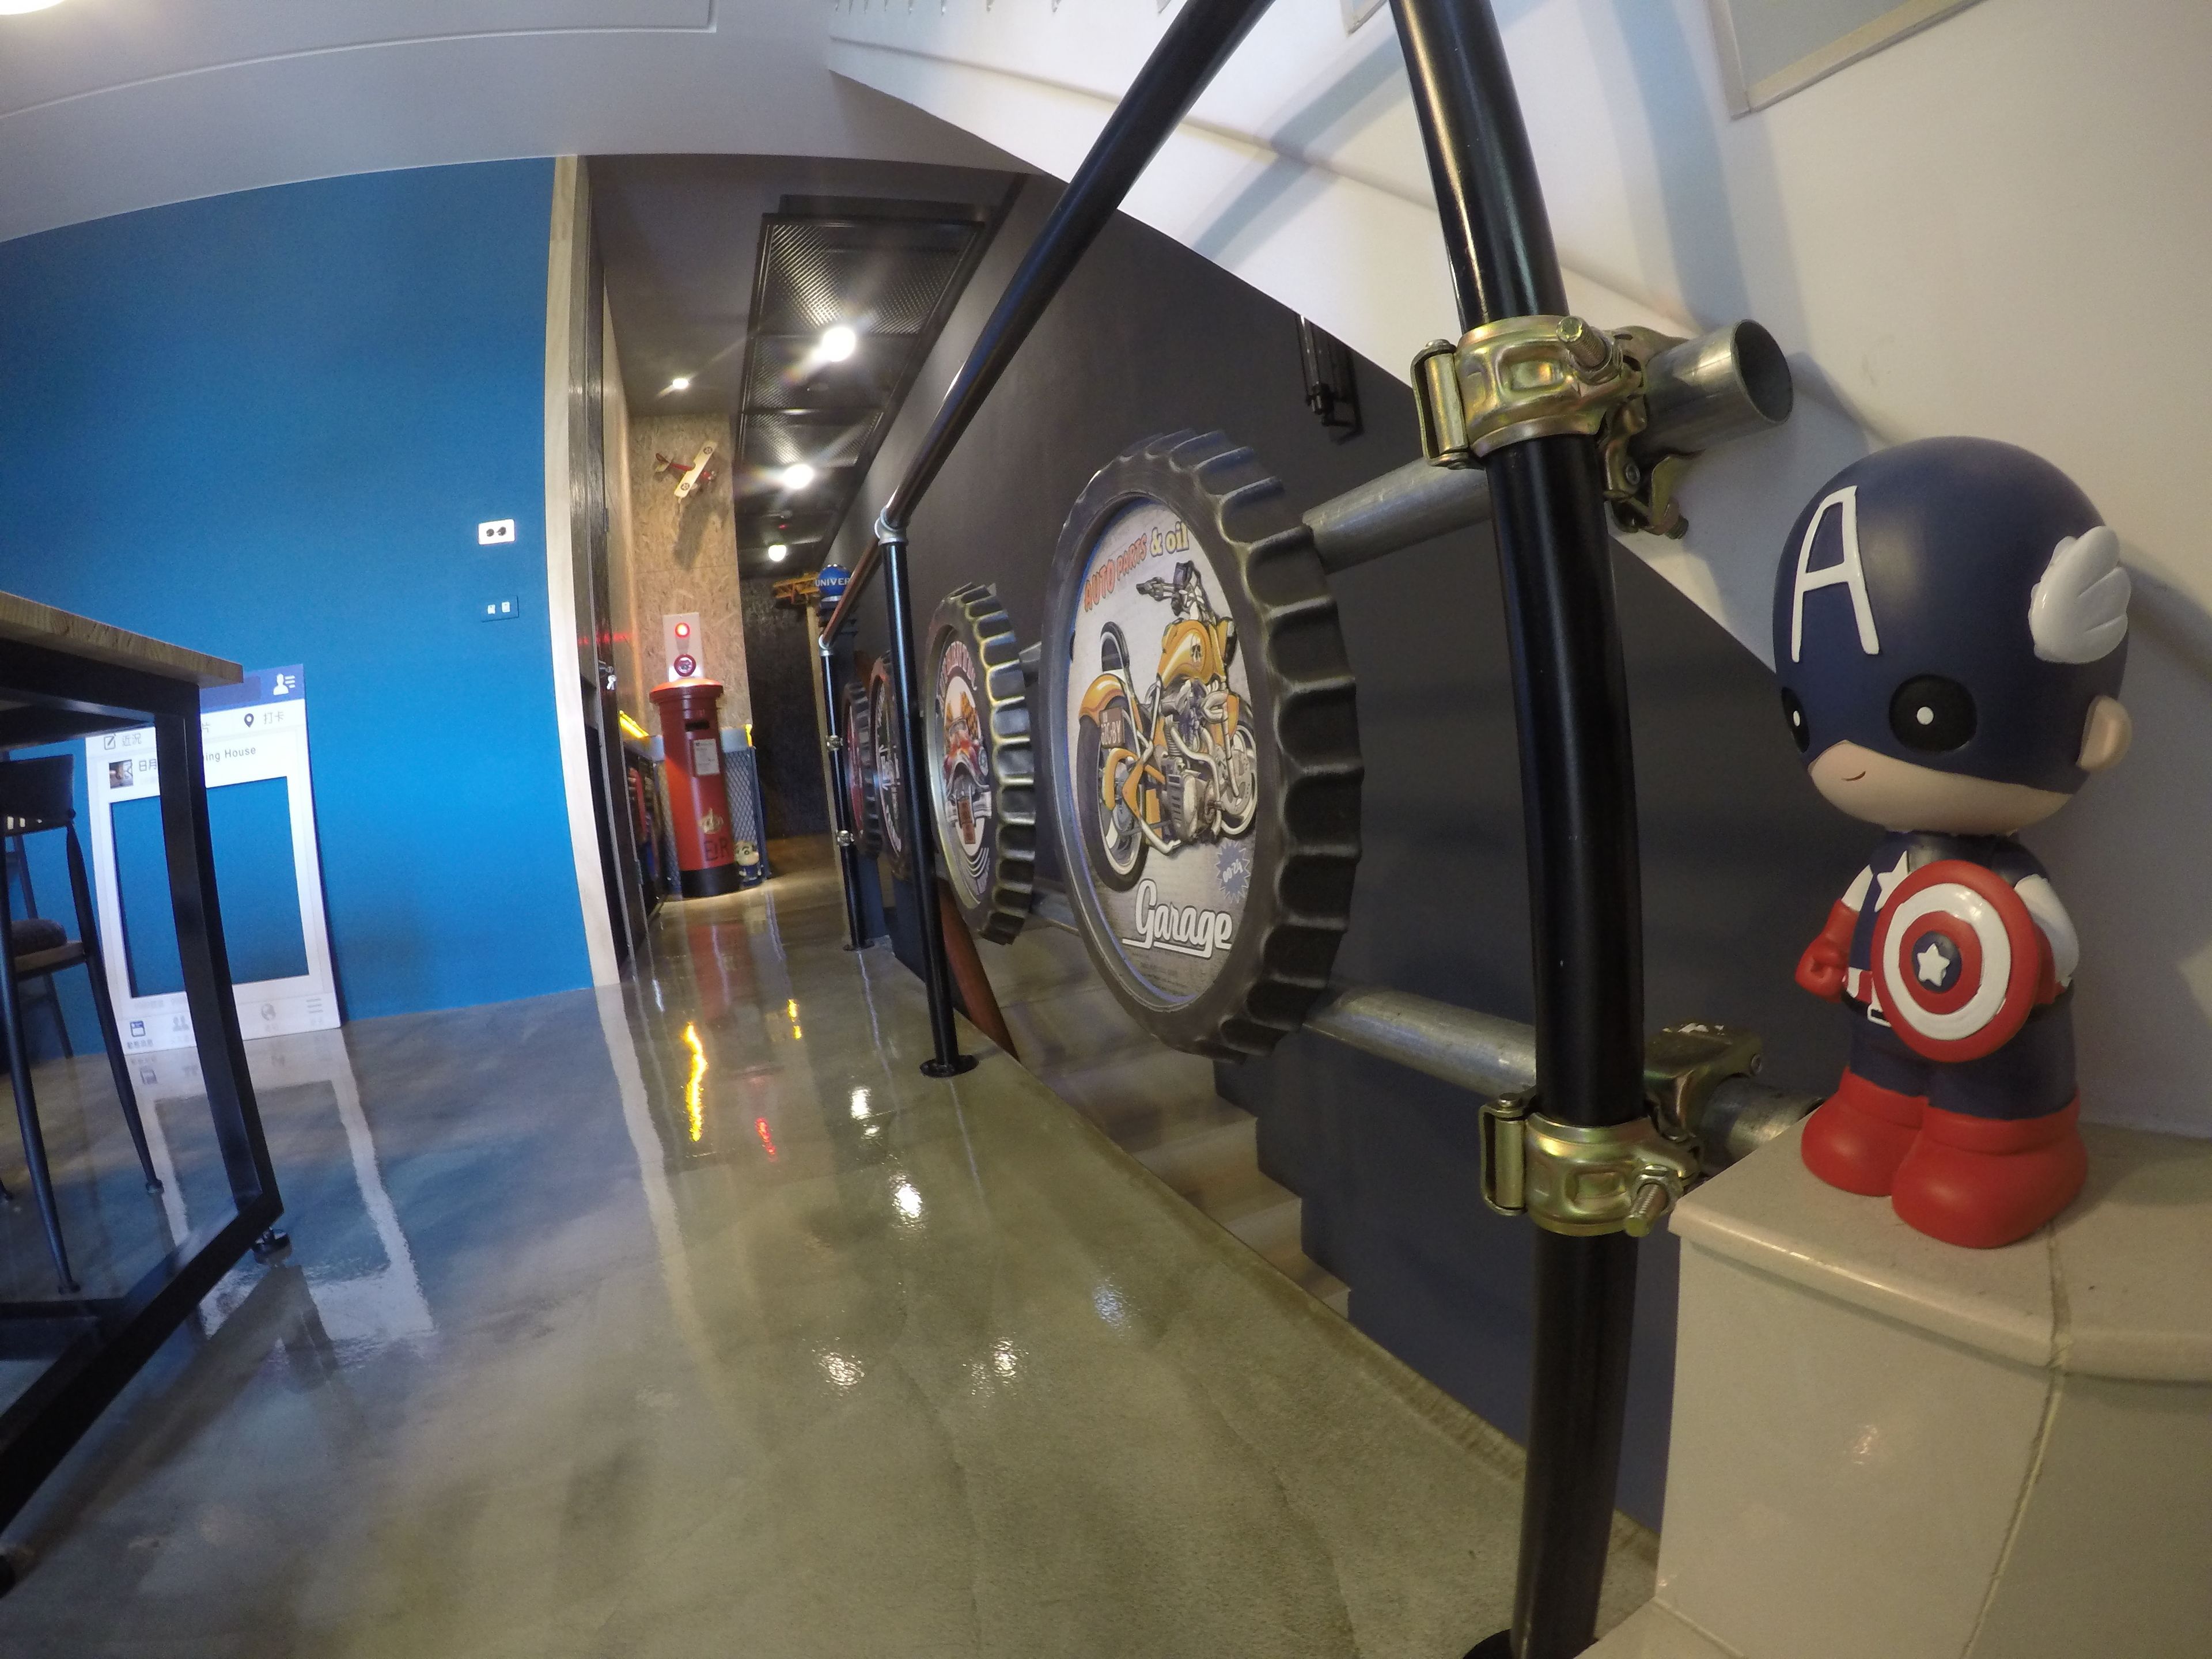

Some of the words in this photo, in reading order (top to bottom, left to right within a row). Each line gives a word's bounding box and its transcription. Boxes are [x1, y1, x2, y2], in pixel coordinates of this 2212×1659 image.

[1084, 559, 1115, 612] AUTO
[1116, 533, 1147, 581] PARTS
[1150, 527, 1164, 558] &
[1165, 521, 1190, 554] oil
[1791, 485, 1880, 663] A
[205, 752, 221, 762] ing
[224, 747, 256, 758] House
[263, 711, 284, 725] 打卡
[1122, 878, 1233, 960] Garage
